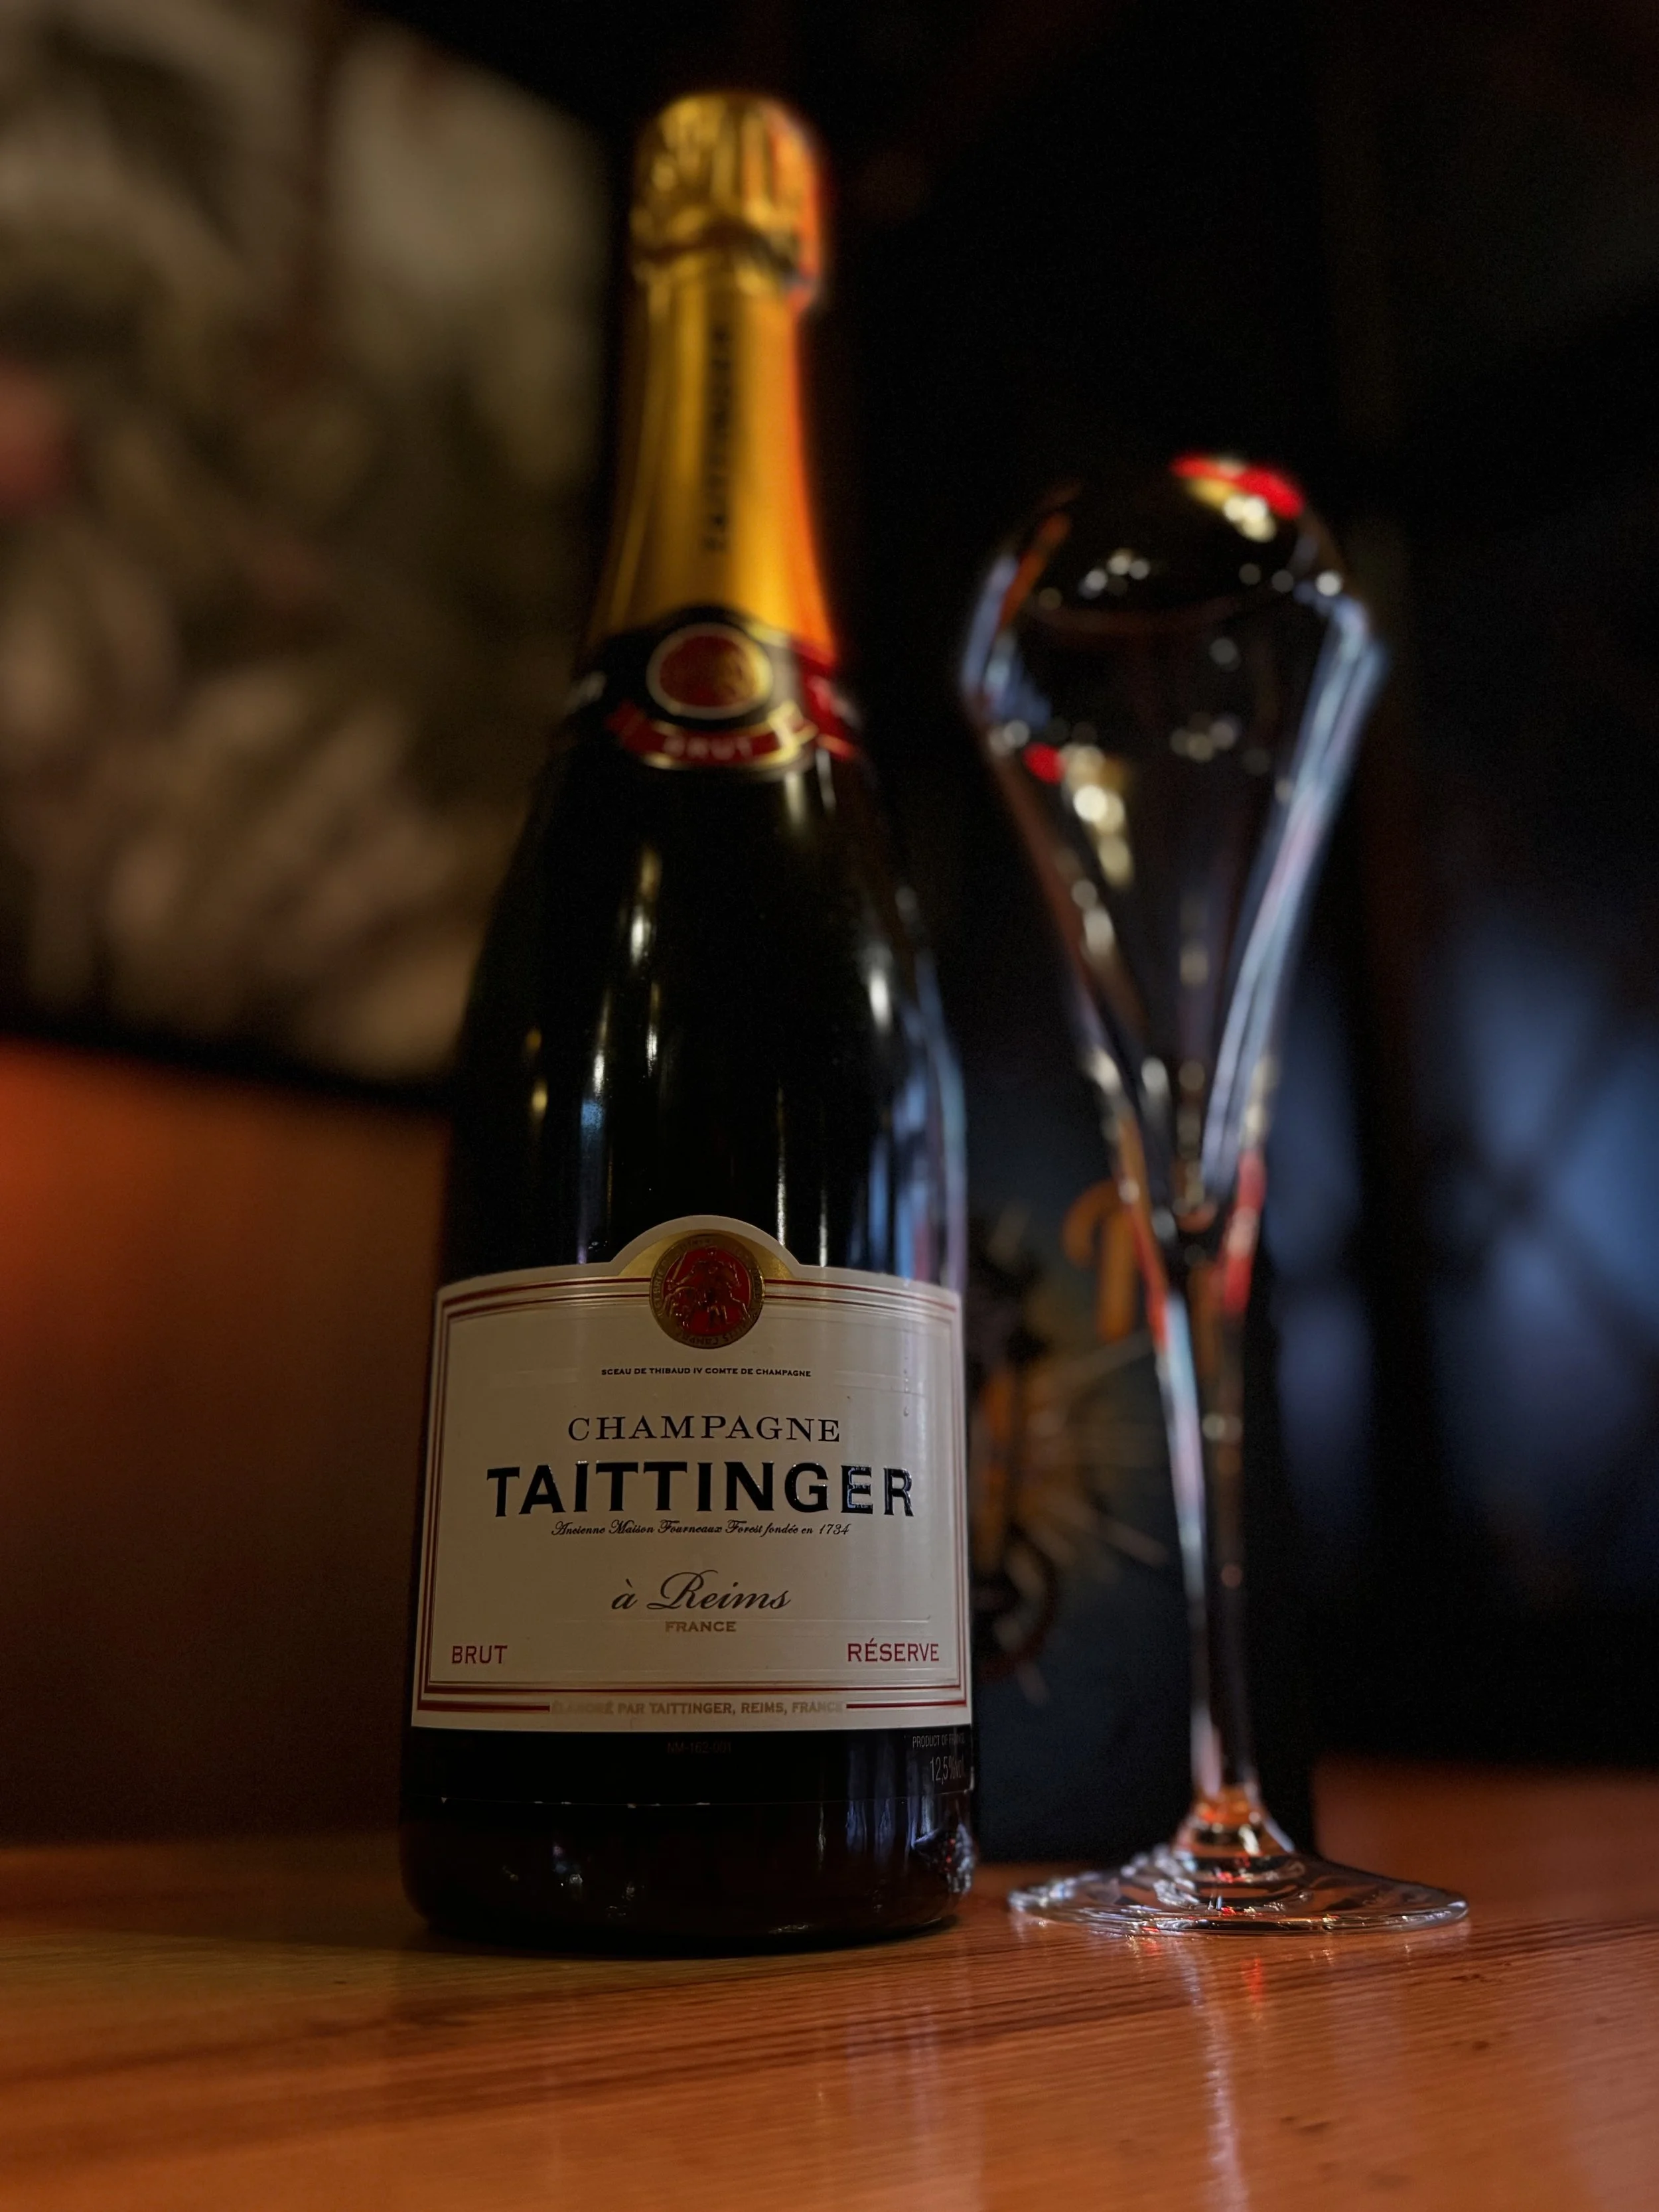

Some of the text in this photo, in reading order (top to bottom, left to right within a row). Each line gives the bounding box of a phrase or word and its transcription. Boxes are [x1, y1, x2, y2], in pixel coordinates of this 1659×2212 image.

[755, 1368, 812, 1378] CHAMPAGNE
[567, 1414, 840, 1443] CHAMPAGNE
[486, 1461, 914, 1518] TAITTINGER
[551, 1518, 851, 1538] Ancienne Maison Fourneaux Forest fondée en 1734
[611, 1569, 792, 1610] à Reims
[664, 1621, 737, 1633] FRANCE
[451, 1645, 508, 1664] BRUT
[847, 1637, 940, 1662] RÉSERVE
[617, 1702, 645, 1715] PAR
[648, 1702, 736, 1716] TAITTINGER,
[741, 1701, 788, 1716] REIMS,
[912, 1735, 940, 1748] PRODUCT
